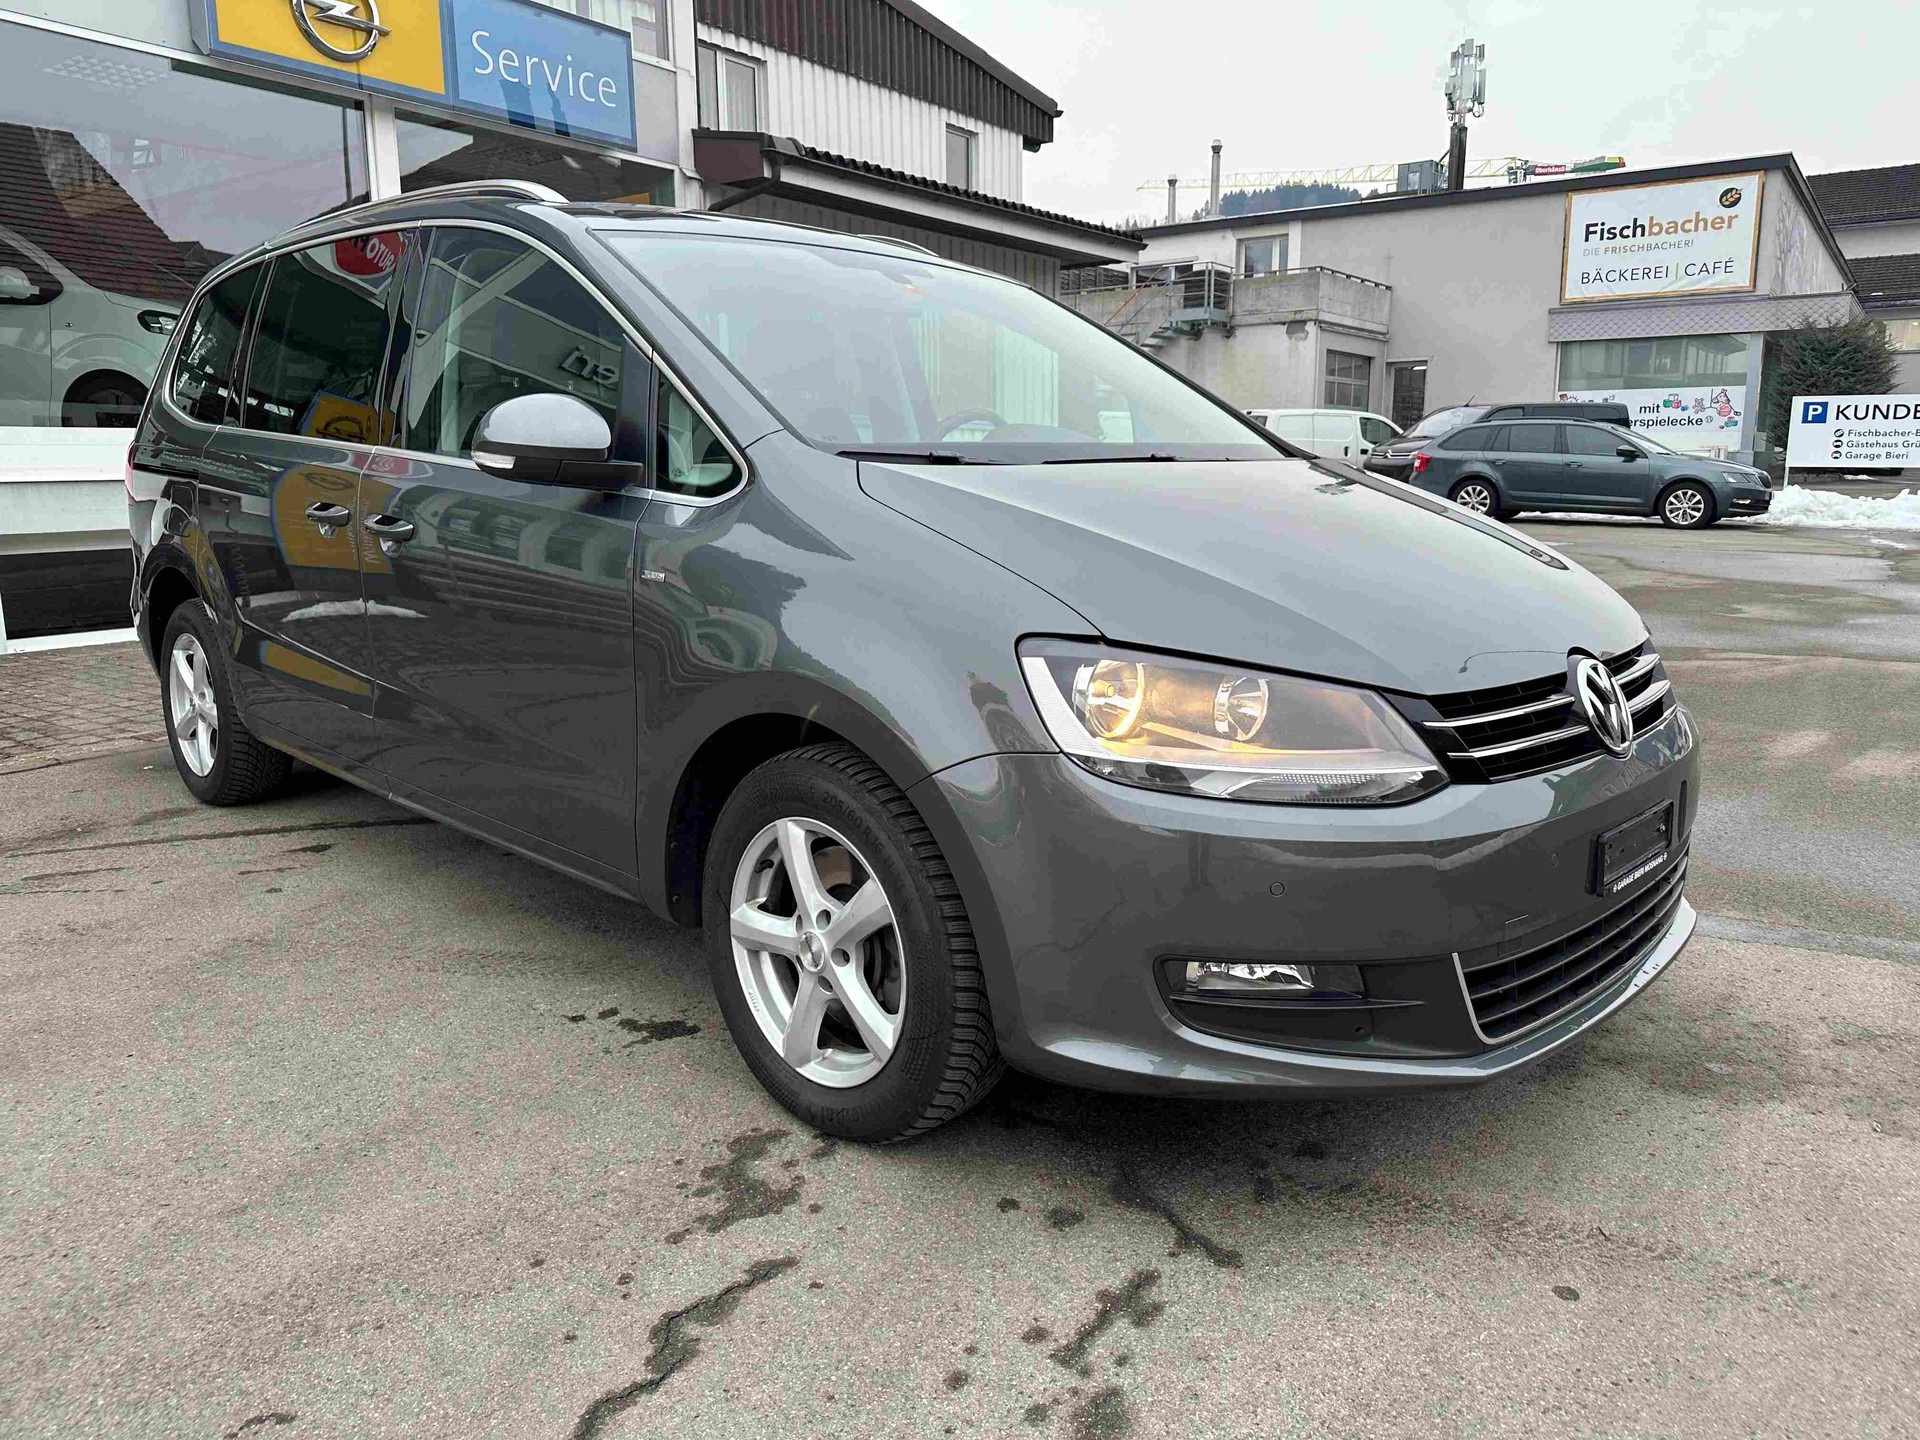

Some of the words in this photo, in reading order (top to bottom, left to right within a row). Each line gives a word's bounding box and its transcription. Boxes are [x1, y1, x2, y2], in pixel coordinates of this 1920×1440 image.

[471, 30, 617, 108] Service
[1584, 211, 1739, 243] Fischbacher
[1583, 247, 1600, 257] DIE
[1604, 239, 1694, 255] FRISCHBACHER!
[1581, 265, 1669, 285] BÄCKEREI
[1684, 257, 1735, 277] CAFÉ
[1639, 403, 1661, 414] mit
[1835, 404, 1920, 421] KUNDE
[1846, 440, 1899, 448] Gästehaus
[1845, 452, 1881, 461] Garage
[1885, 452, 1909, 460] Bieri
